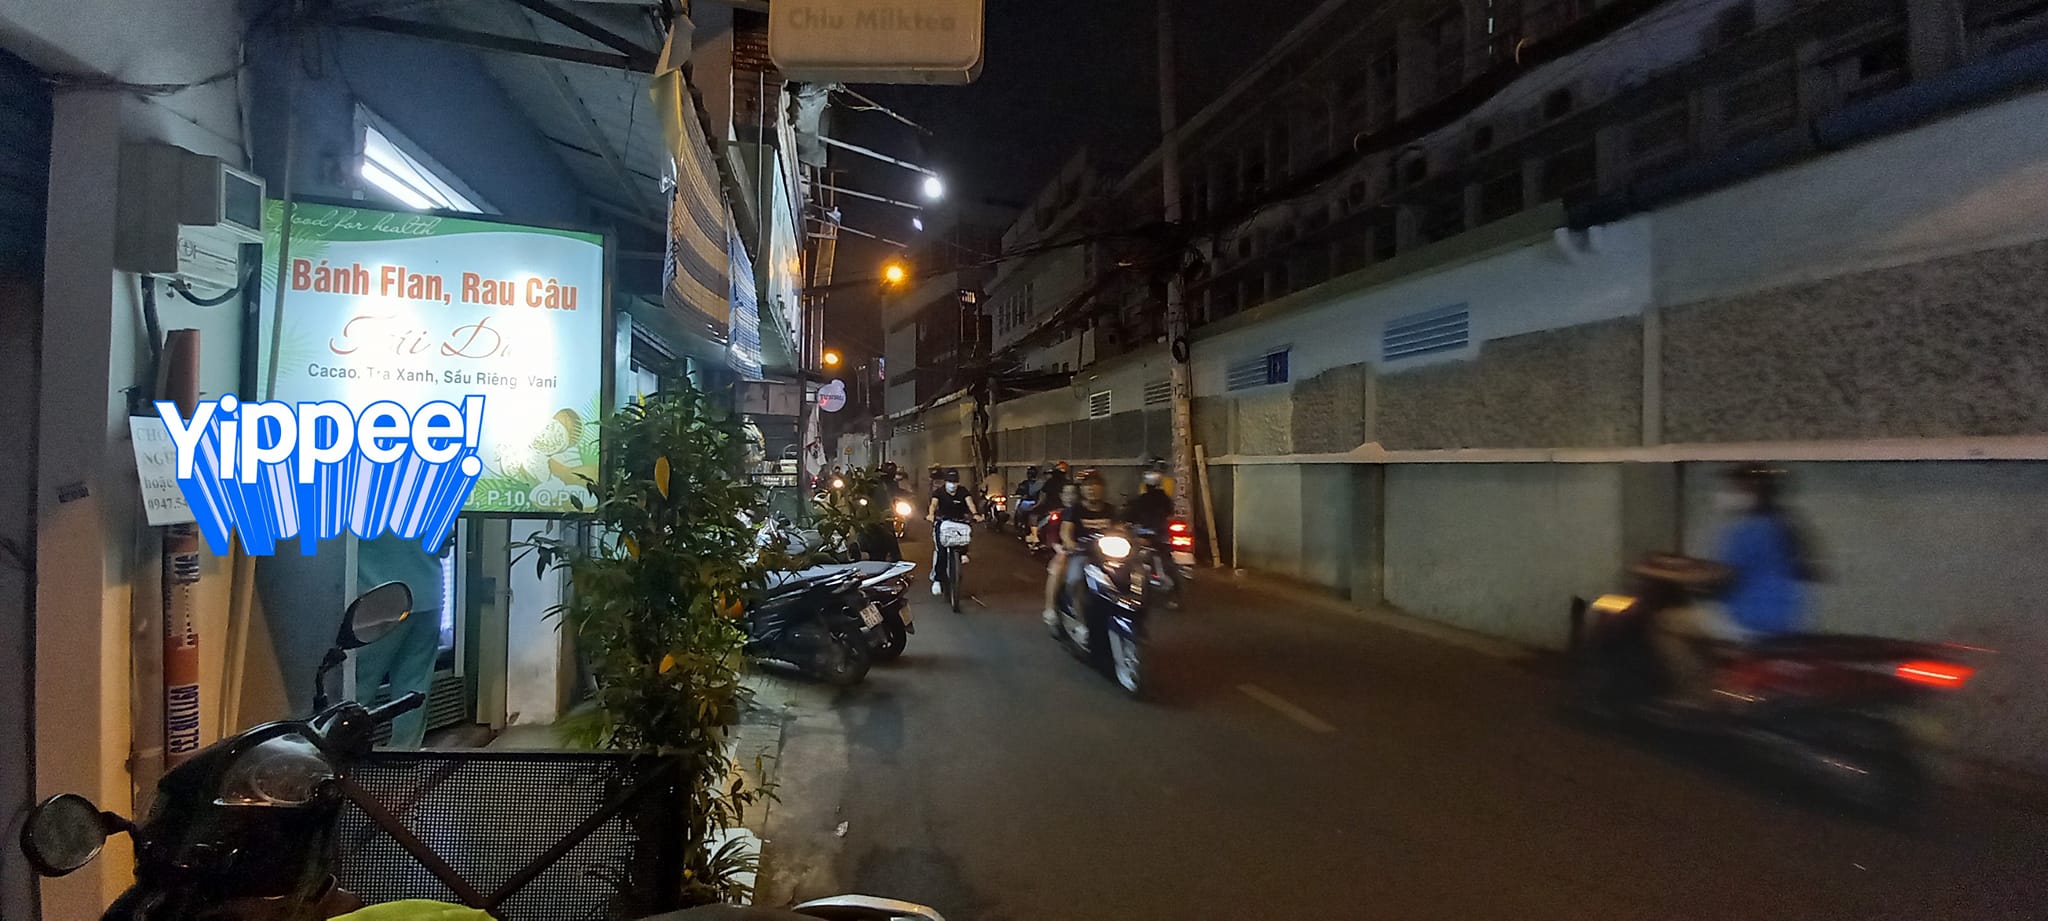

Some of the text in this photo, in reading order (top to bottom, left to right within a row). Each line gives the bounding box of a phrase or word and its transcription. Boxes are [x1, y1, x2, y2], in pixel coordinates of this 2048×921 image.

[317, 209, 368, 237] for
[373, 213, 441, 235] health
[292, 258, 578, 310] Bánh Flan, Rau Câu
[396, 368, 438, 385] Xanh,
[528, 376, 557, 389] Vani
[488, 490, 531, 508] P.10,
